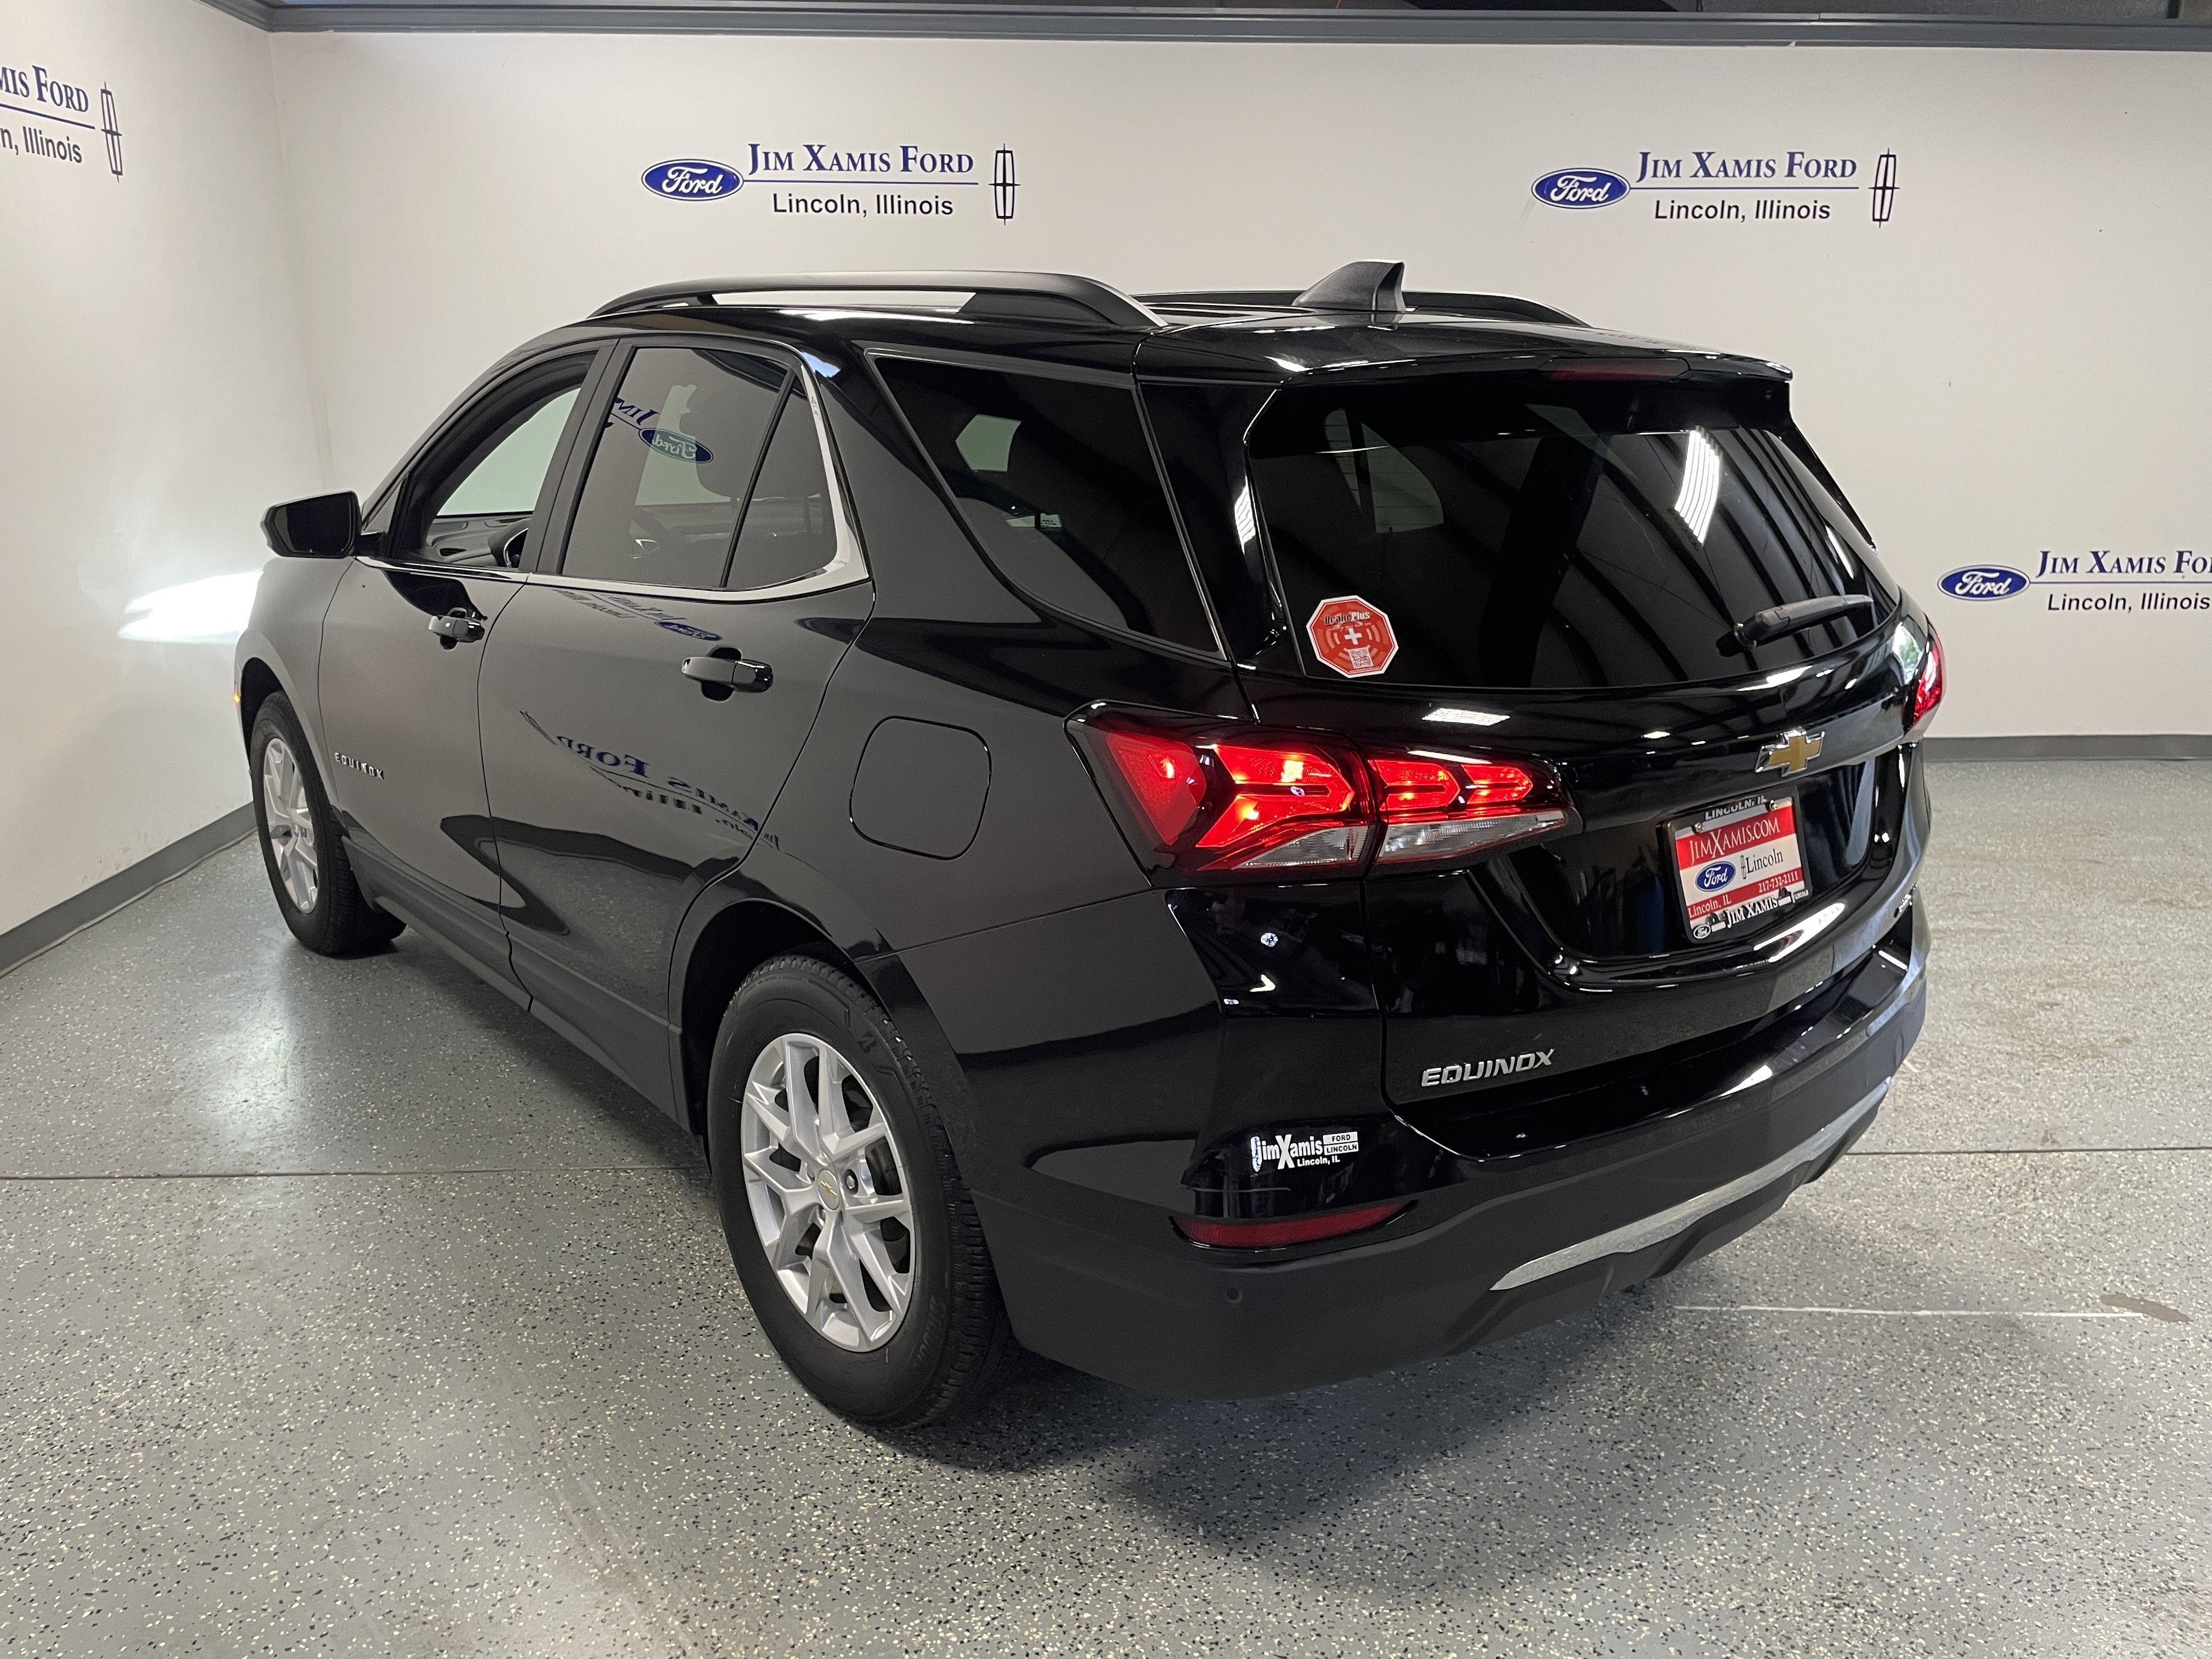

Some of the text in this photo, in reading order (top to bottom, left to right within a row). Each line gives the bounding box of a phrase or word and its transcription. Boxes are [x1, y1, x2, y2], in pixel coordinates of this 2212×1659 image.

[32, 65, 89, 112] FORD
[22, 126, 82, 163] Illinois
[748, 143, 974, 176] JIM XAMIS FORD
[1636, 151, 1857, 183] JIM XAMIS FORD
[662, 166, 723, 195] Ford
[1549, 175, 1611, 203] Ford
[773, 193, 953, 218] Lincoln, Illinois
[1655, 199, 1831, 223] Lincoln, Illinois
[2036, 550, 2212, 578] JIM XAMIS FO
[1955, 571, 2012, 596] Ford
[2048, 592, 2210, 613] Lincoln, Illinois
[335, 752, 385, 781] EQUINOX
[1745, 848, 1784, 874] Lincoln
[1704, 866, 1728, 888] Ford
[1723, 894, 1733, 906] IL
[1724, 896, 1779, 928] JIM XAMIS
[1421, 1047, 1555, 1087] EQUINOX
[1326, 1144, 1358, 1153] LINCOLN
[1331, 1134, 1351, 1142] FORD
[1297, 1155, 1340, 1167] Lincoln, IL
